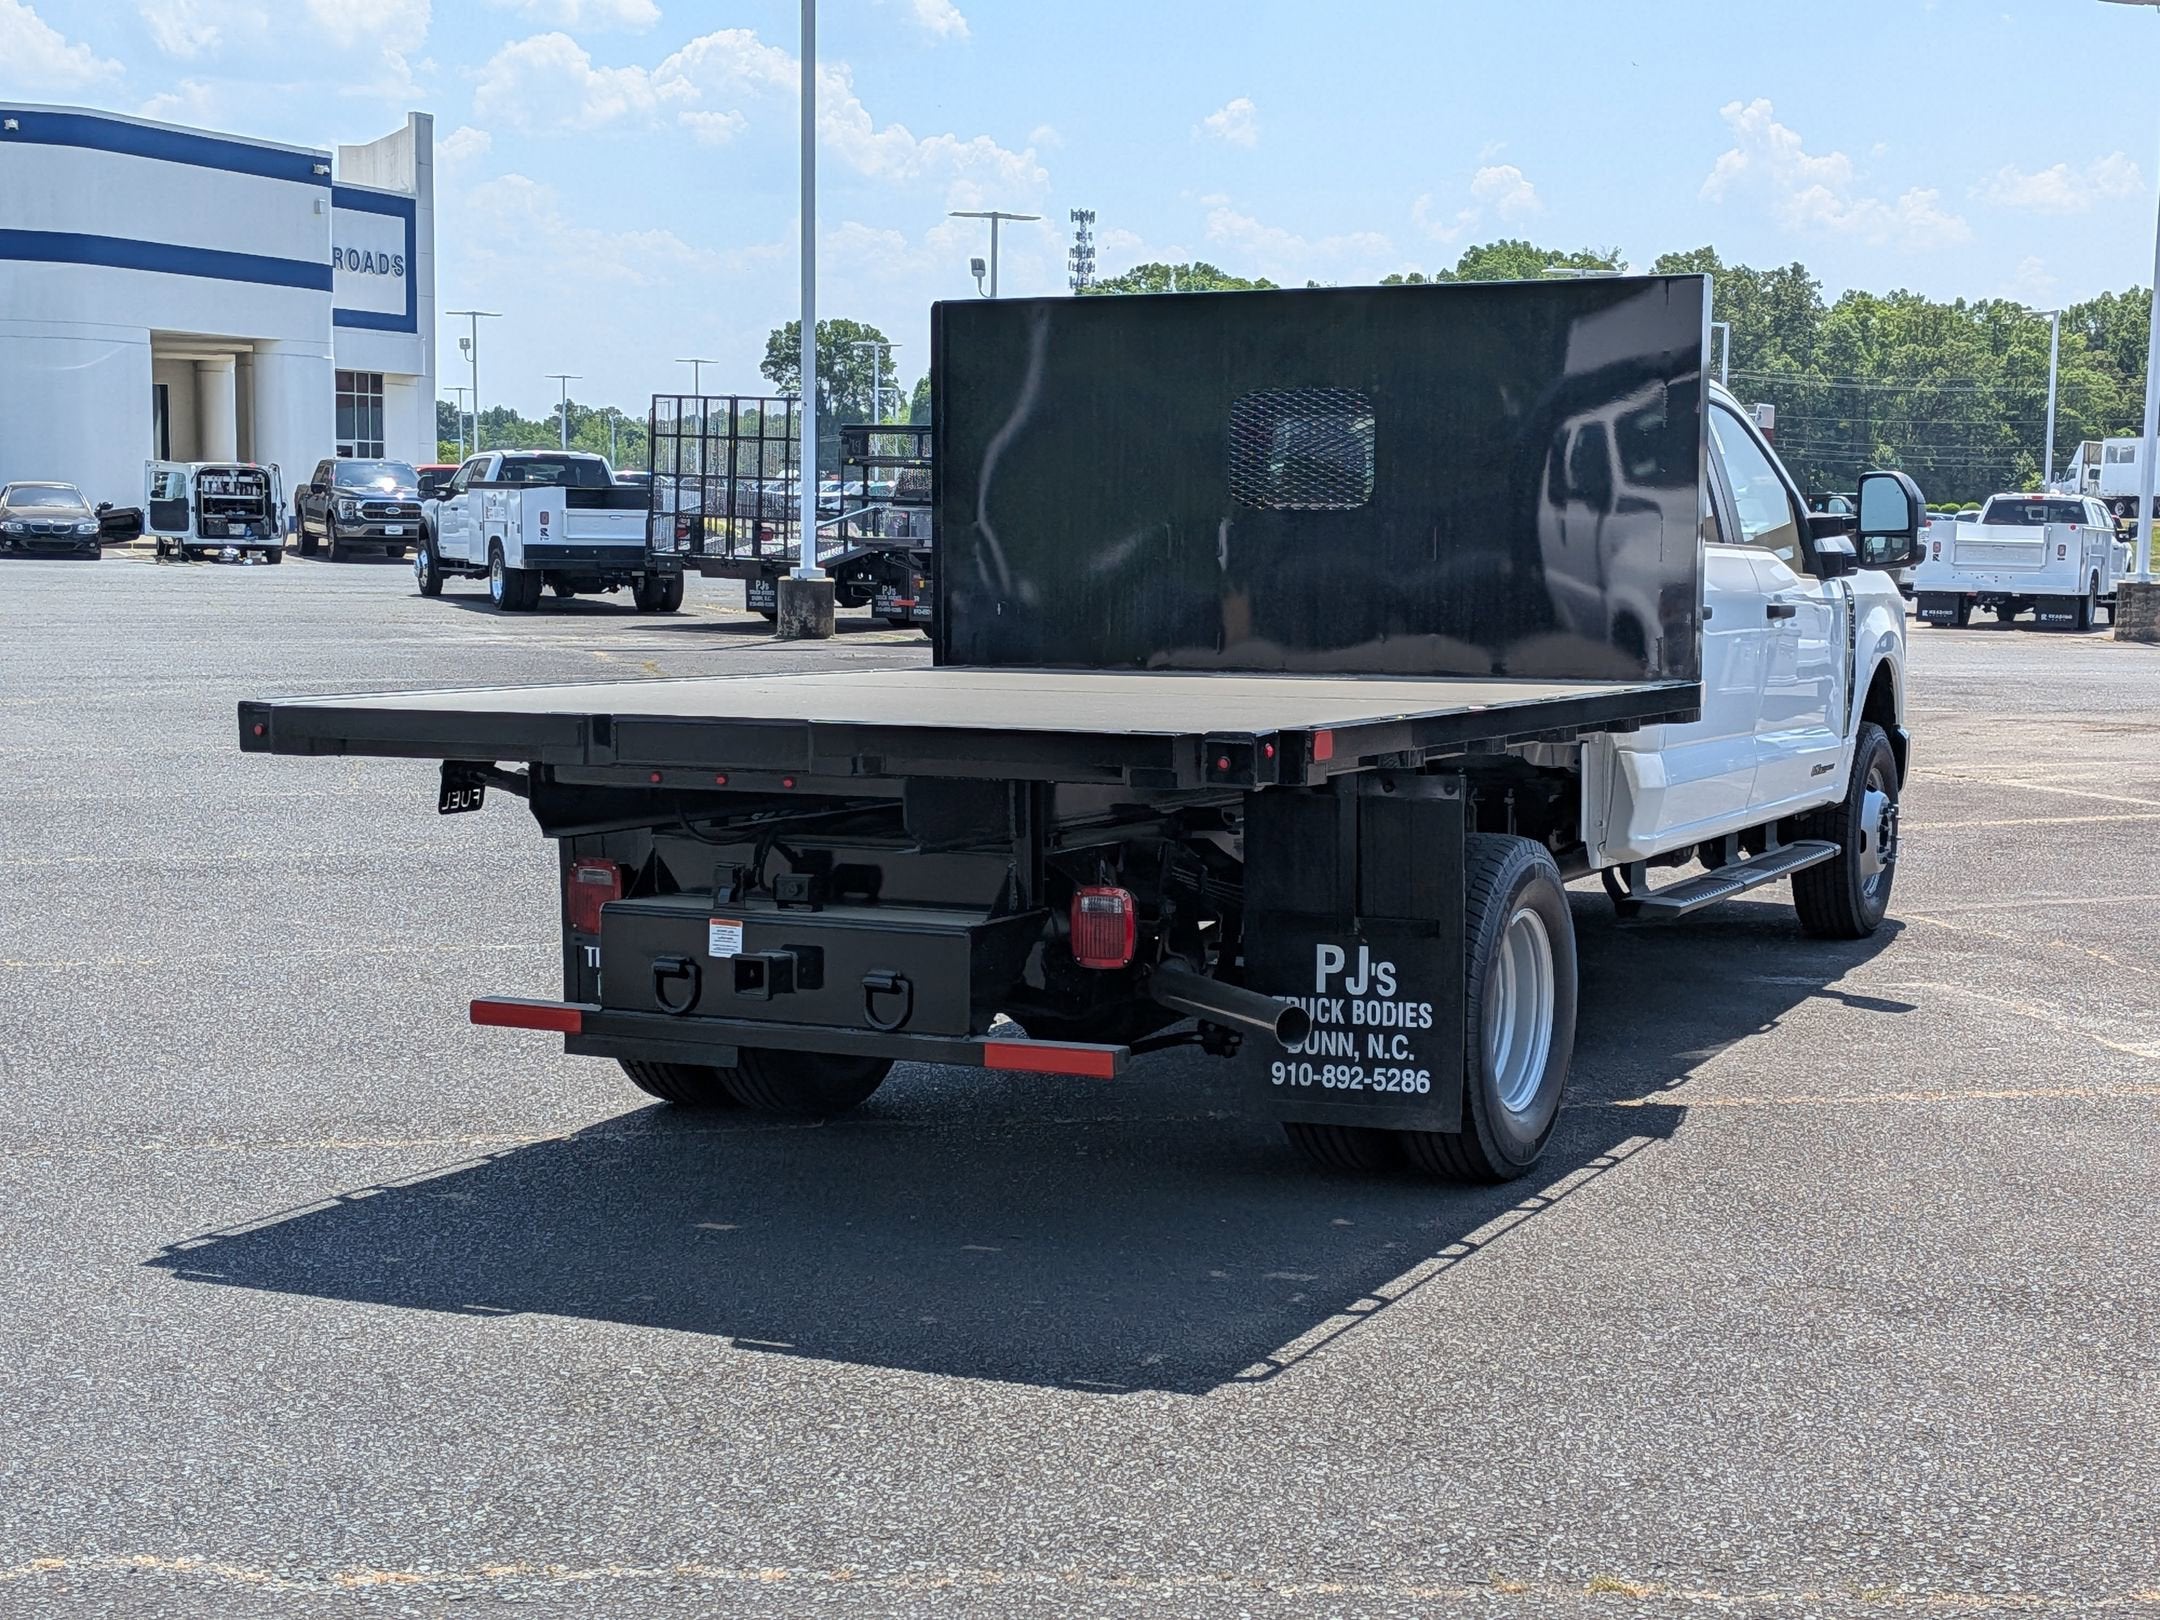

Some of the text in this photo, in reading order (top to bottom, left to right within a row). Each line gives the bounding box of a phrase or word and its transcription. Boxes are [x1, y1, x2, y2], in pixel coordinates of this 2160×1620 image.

[332, 246, 405, 277] ROADS
[1315, 943, 1397, 997] PJ's
[1272, 995, 1433, 1029] UCK BODIES
[1287, 1031, 1415, 1063] UNN, N.C.
[1271, 1062, 1431, 1094] 910-892-5286
